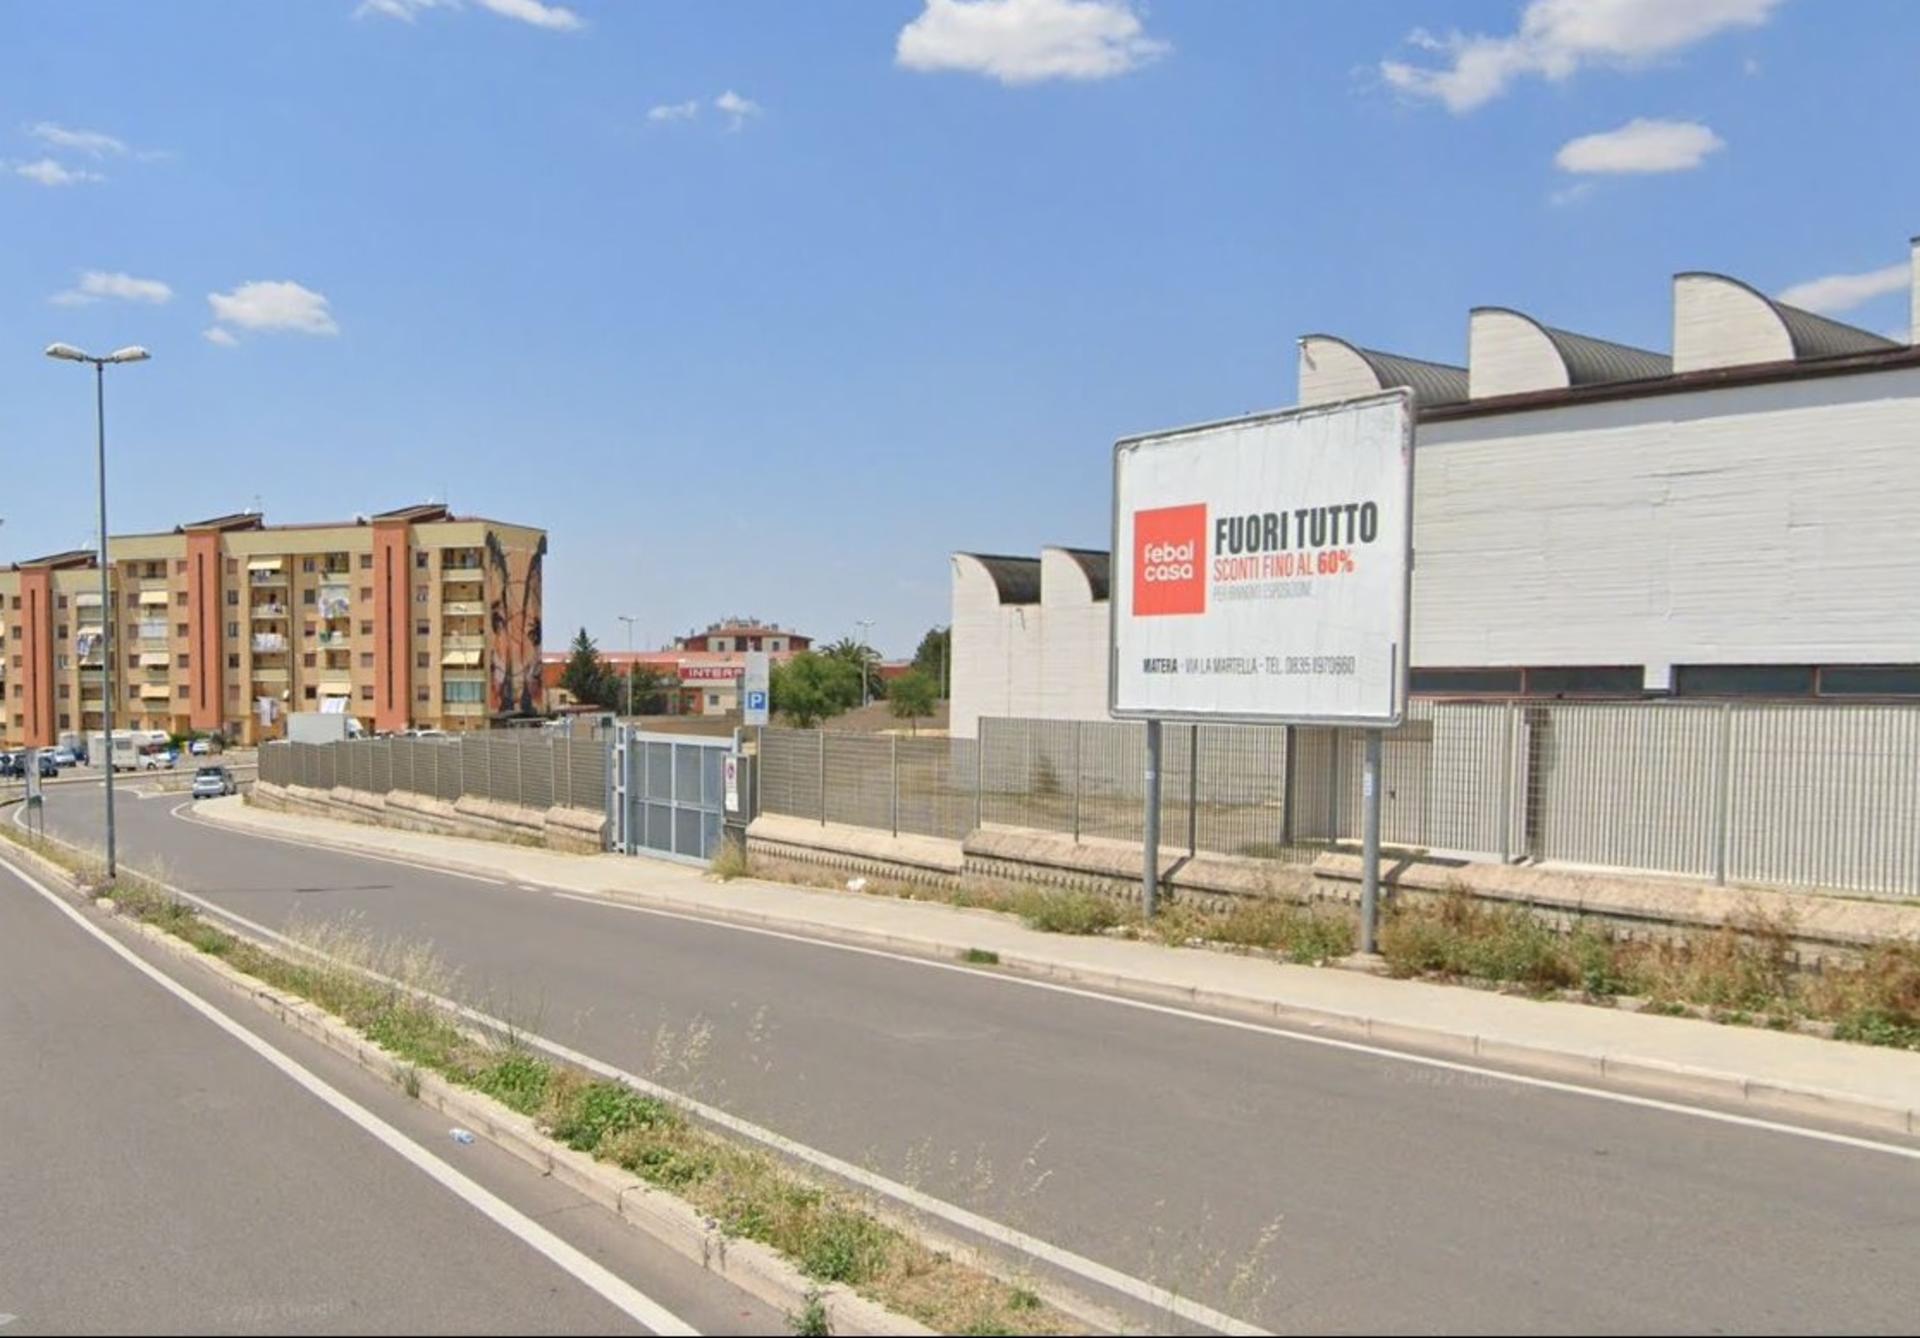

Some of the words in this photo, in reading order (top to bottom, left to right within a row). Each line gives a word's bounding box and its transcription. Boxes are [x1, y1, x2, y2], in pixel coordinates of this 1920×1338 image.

[1215, 511, 1288, 556] FUORI
[1294, 501, 1378, 548] TUTTO
[1144, 541, 1194, 564] febal
[1144, 563, 1194, 582] casa
[1213, 556, 1260, 582] SCONTI
[1263, 553, 1294, 579] FINO
[1297, 552, 1313, 576] AL
[1317, 550, 1354, 574] 60%
[1143, 658, 1178, 674] MATERA
[1213, 657, 1257, 674] MARTELLA
[751, 694, 763, 709] P
